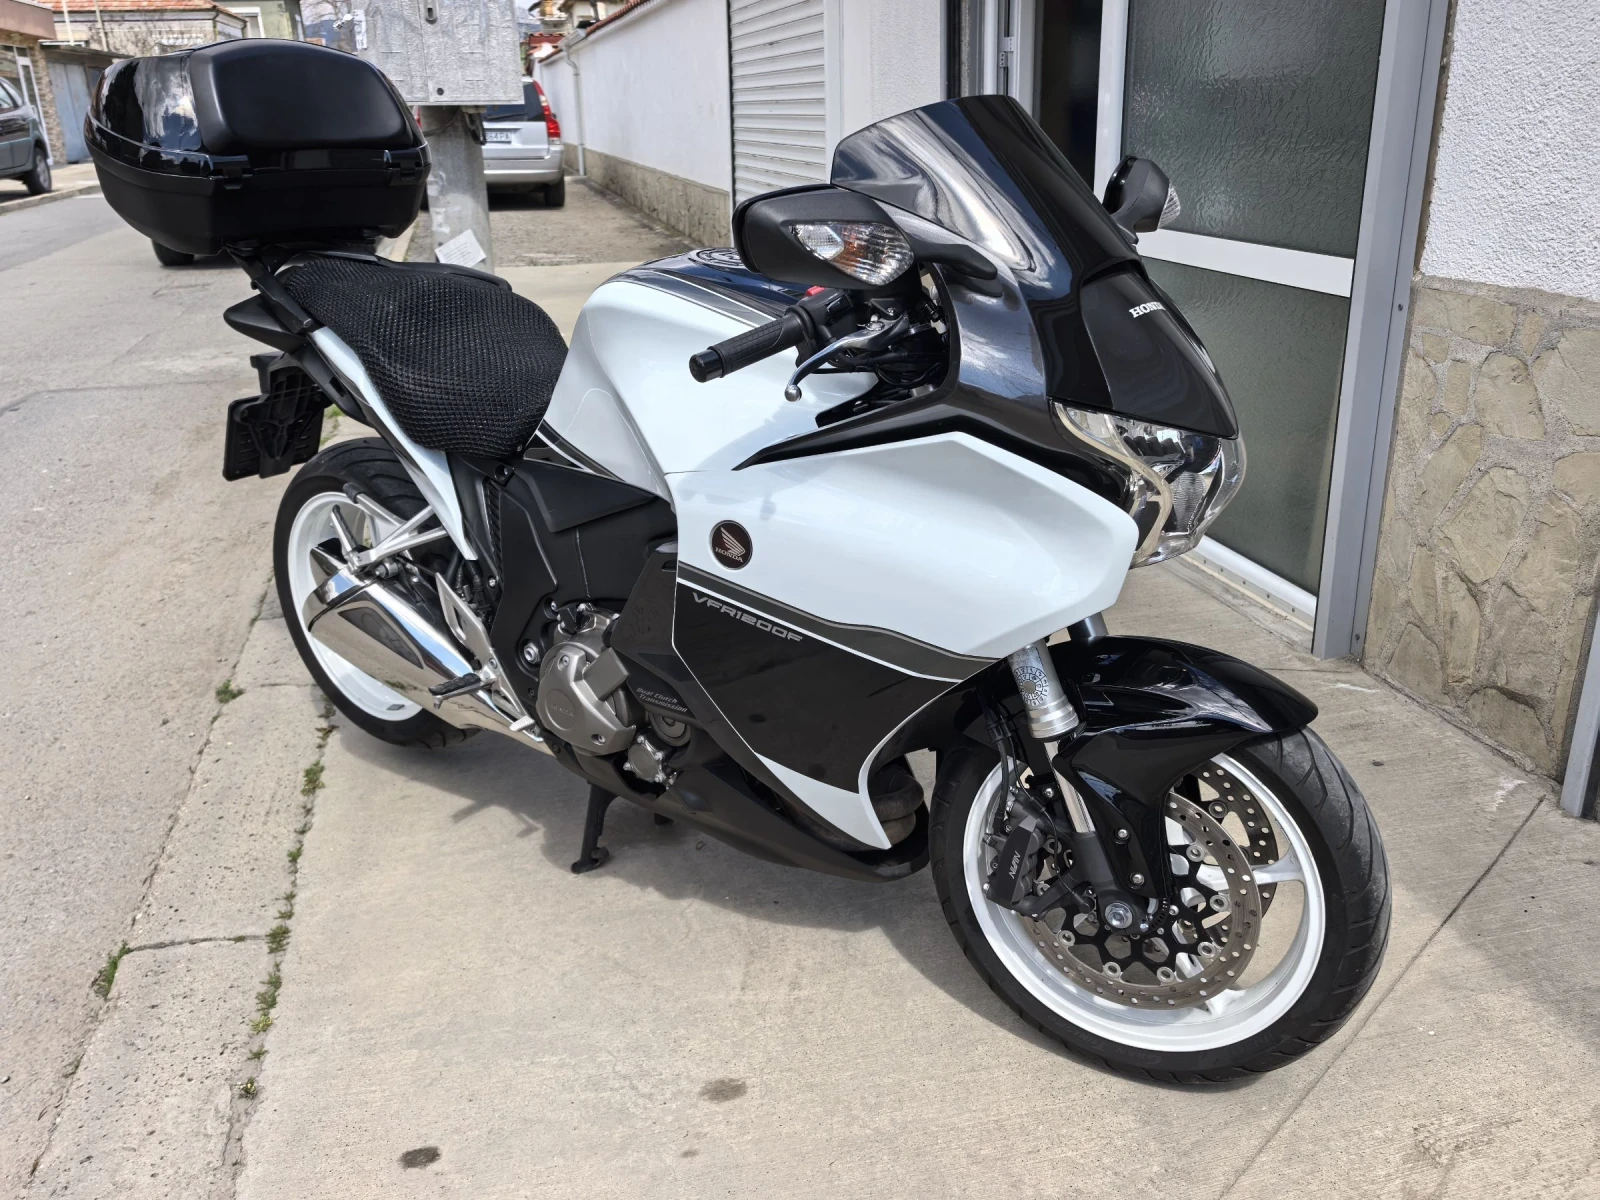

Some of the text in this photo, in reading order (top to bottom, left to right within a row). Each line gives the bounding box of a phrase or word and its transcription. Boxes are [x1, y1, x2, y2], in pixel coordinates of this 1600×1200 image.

[715, 546, 743, 562] HONDA
[692, 591, 803, 642] VFR1200F
[637, 688, 677, 703] Dual Clutch
[639, 694, 688, 712] Transmission
